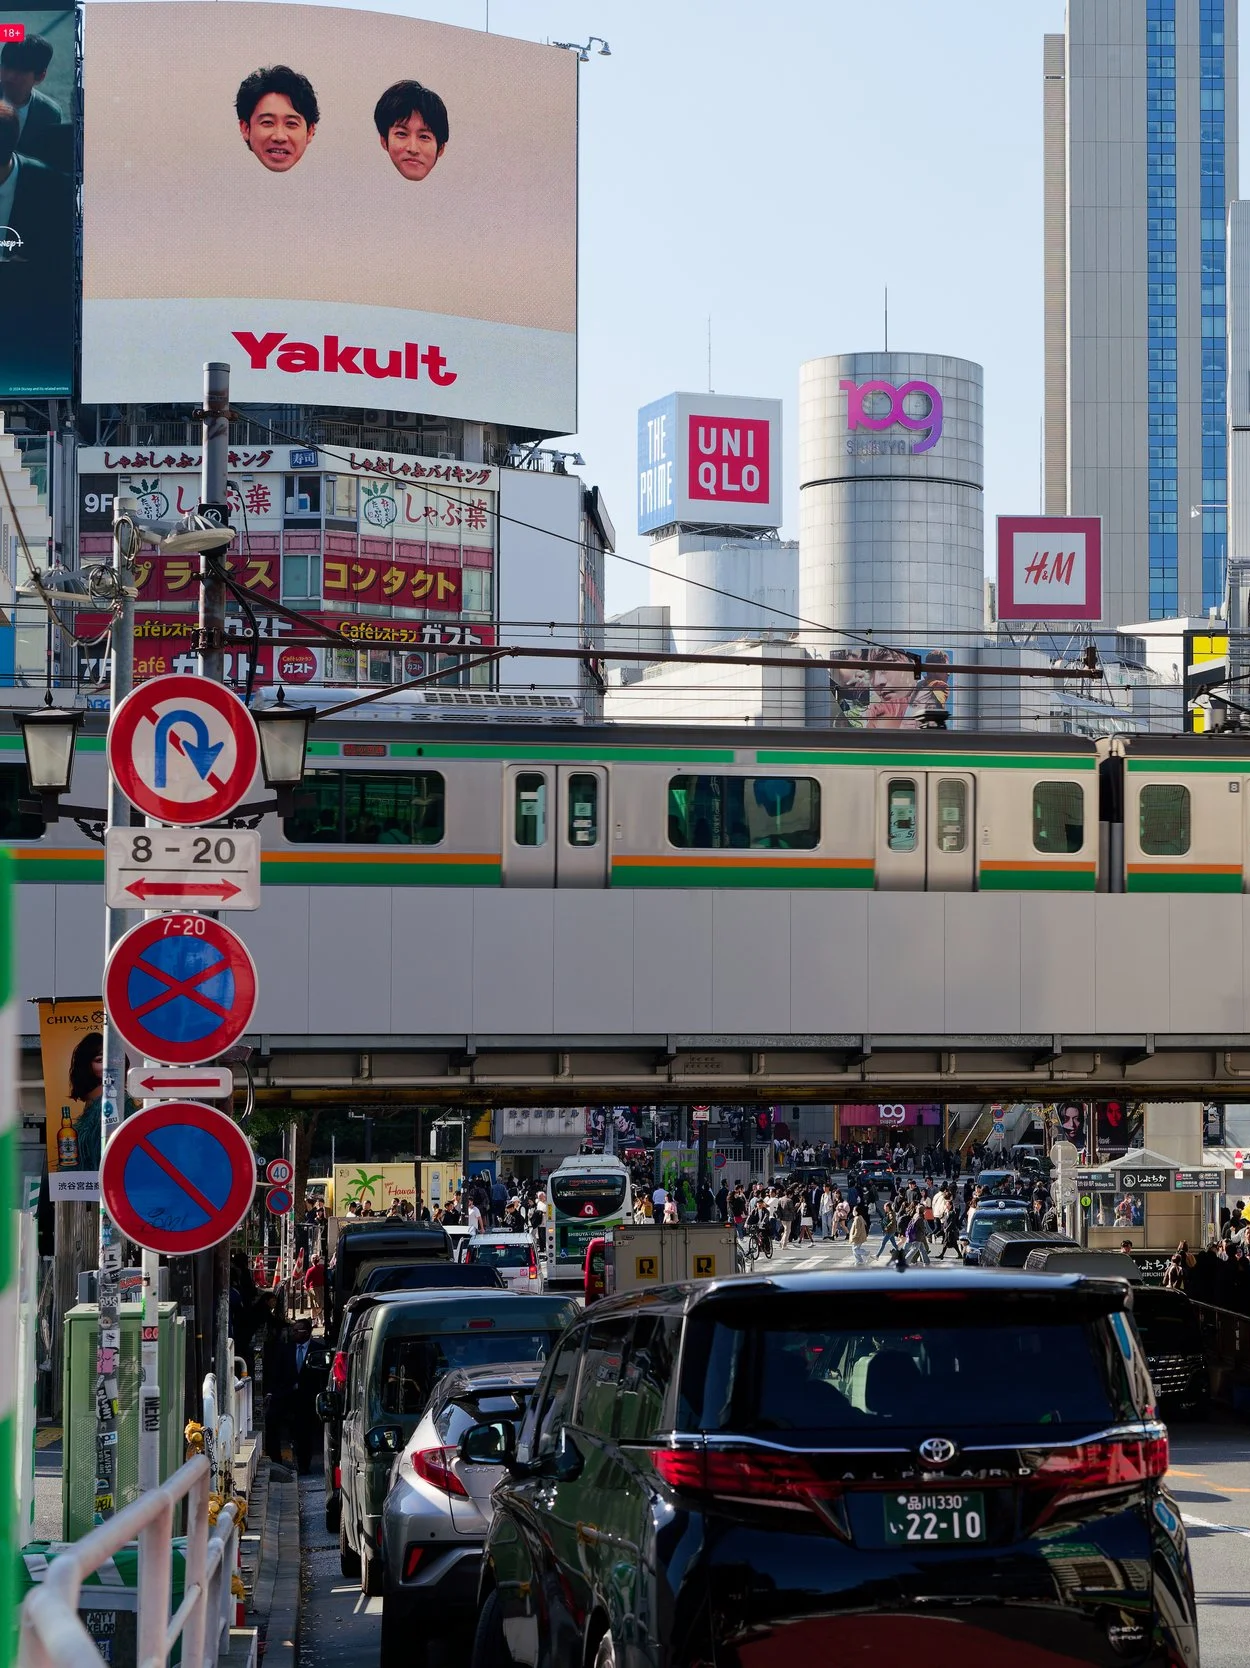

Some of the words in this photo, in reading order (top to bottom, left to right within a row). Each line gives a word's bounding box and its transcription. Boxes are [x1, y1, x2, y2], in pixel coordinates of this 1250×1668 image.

[3, 28, 20, 37] 18+
[231, 331, 458, 387] Yakult
[839, 379, 943, 455] 109
[648, 414, 666, 464] THE
[698, 426, 754, 458] UNI
[104, 451, 274, 469] しゃぶしゃぶキング
[292, 451, 316, 466] 寿司
[350, 452, 492, 485] しゃぶしゃぶバイキング
[640, 460, 672, 516] PRIME
[698, 461, 760, 495] QLO
[85, 493, 113, 513] 9F
[406, 492, 488, 530] しゃぶ葉
[134, 561, 274, 590] プラス
[324, 562, 456, 600] コンタクト
[283, 663, 314, 674] ガスト
[1230, 783, 1238, 791] 8
[162, 918, 206, 935] 7-20
[47, 1015, 88, 1025] CHIVAS
[878, 1104, 905, 1124] 109
[273, 1166, 288, 1179] 40
[1137, 1174, 1167, 1183] しぶちか
[584, 1204, 593, 1215] Q
[103, 1449, 112, 1475] LAVISH
[842, 1467, 1031, 1480] ALPHARD
[889, 1521, 904, 1535] い
[905, 1511, 981, 1540] 22-10
